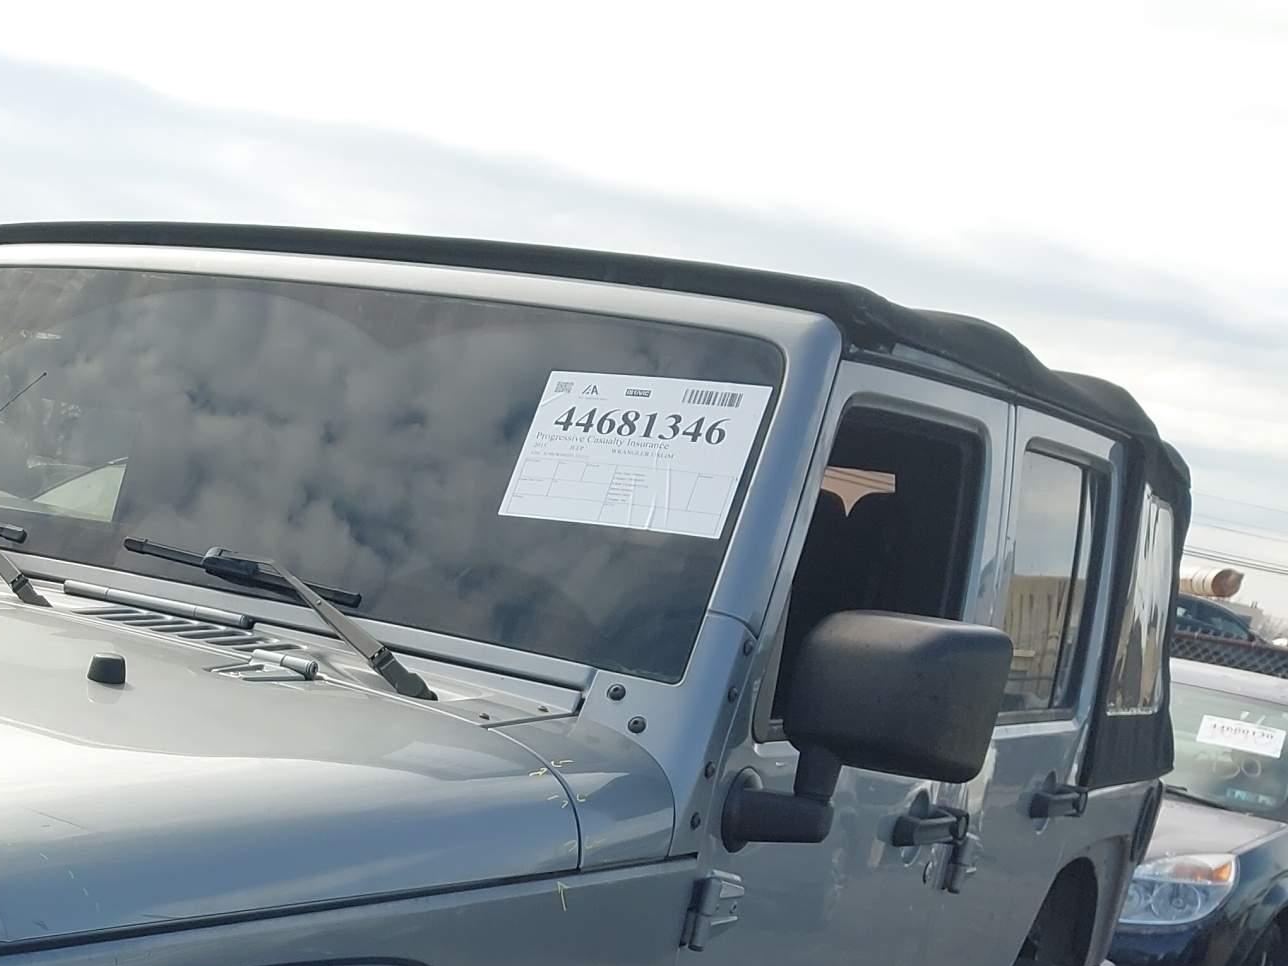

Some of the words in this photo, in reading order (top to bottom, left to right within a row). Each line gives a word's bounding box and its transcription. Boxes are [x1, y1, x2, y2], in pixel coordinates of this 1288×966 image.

[535, 431, 585, 444] Progressive
[587, 435, 623, 448] Casualty
[626, 437, 670, 450] Insurance
[553, 405, 731, 446] 44681346
